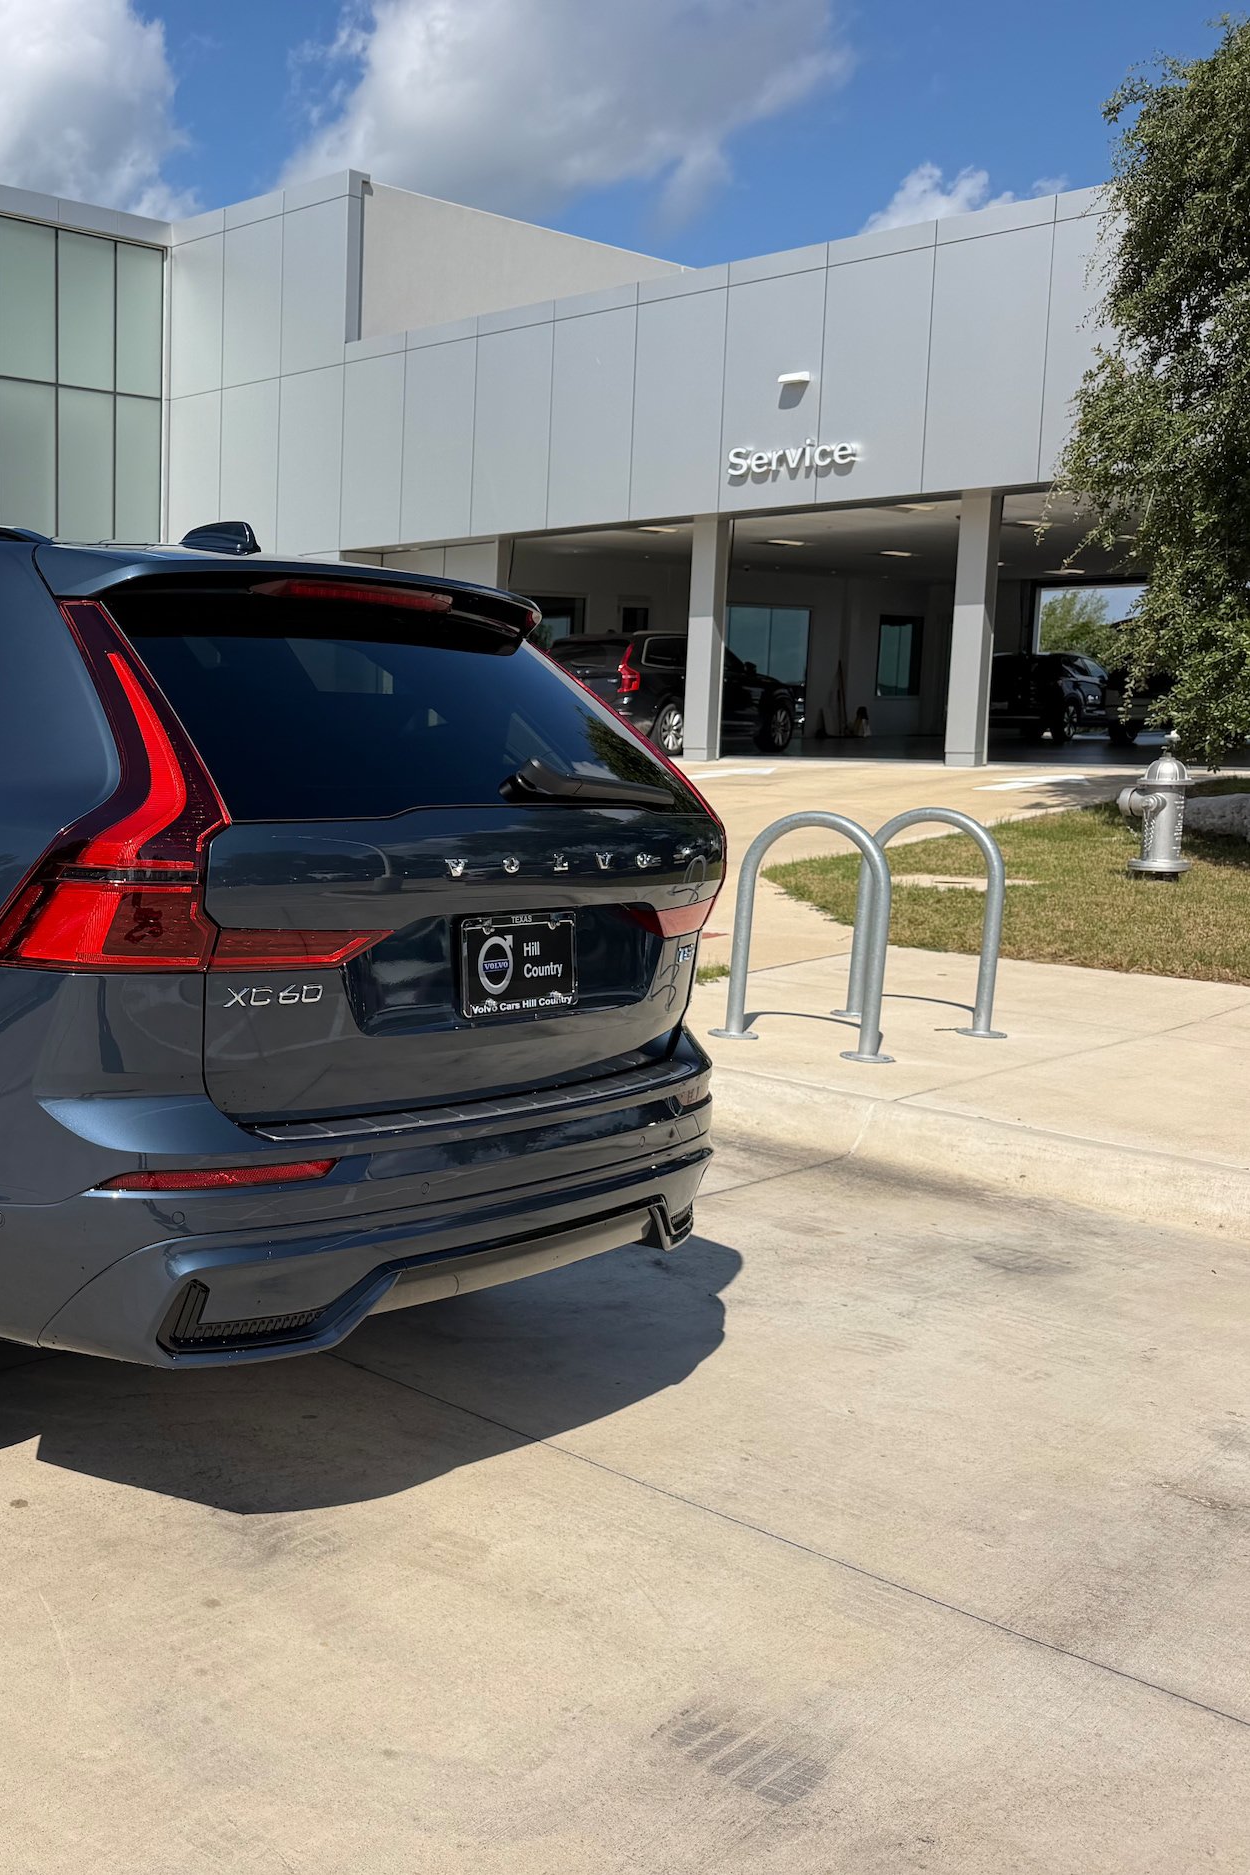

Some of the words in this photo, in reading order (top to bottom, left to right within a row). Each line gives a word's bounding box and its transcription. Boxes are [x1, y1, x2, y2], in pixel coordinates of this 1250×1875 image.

[727, 438, 857, 476] Service
[444, 852, 653, 877] VOLVO
[510, 914, 533, 924] TEXAS
[523, 941, 541, 957] Hill
[483, 961, 509, 971] VOLVO
[523, 961, 563, 979] Country
[223, 983, 324, 1008] XC60
[471, 1001, 498, 1015] Volvo
[499, 1001, 521, 1012] Cars
[522, 998, 537, 1009] Hill
[538, 994, 573, 1007] Country
